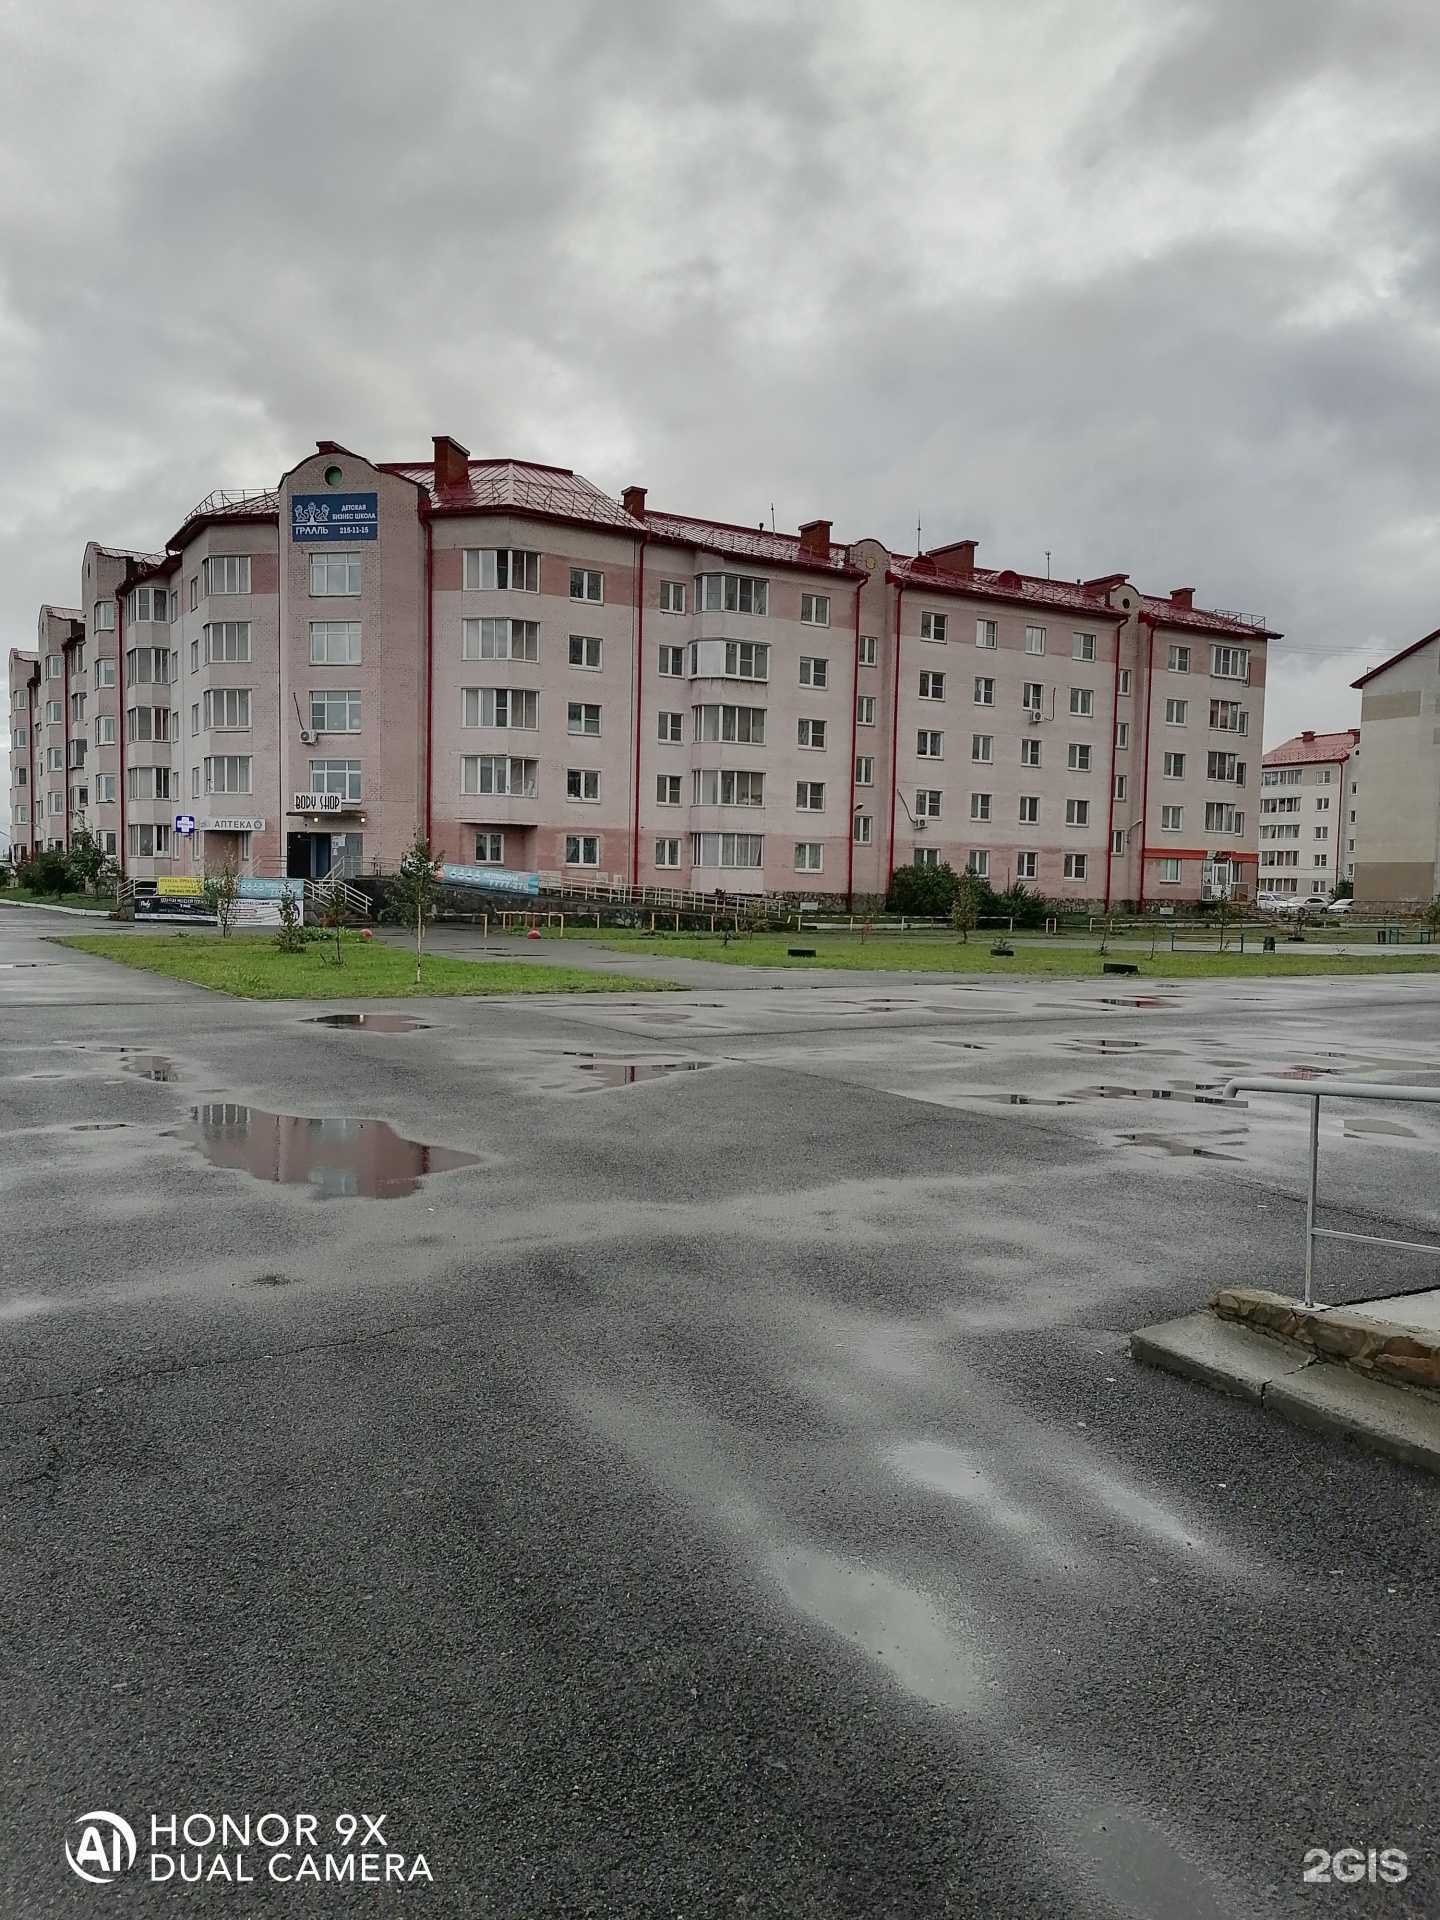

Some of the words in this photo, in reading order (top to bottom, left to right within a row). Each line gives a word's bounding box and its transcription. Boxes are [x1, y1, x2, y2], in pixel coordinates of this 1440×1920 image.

[295, 526, 329, 535] ГРААЛЬ
[295, 795, 317, 810] BODY
[319, 795, 340, 810] SHOP
[214, 820, 252, 829] АПТЕКА
